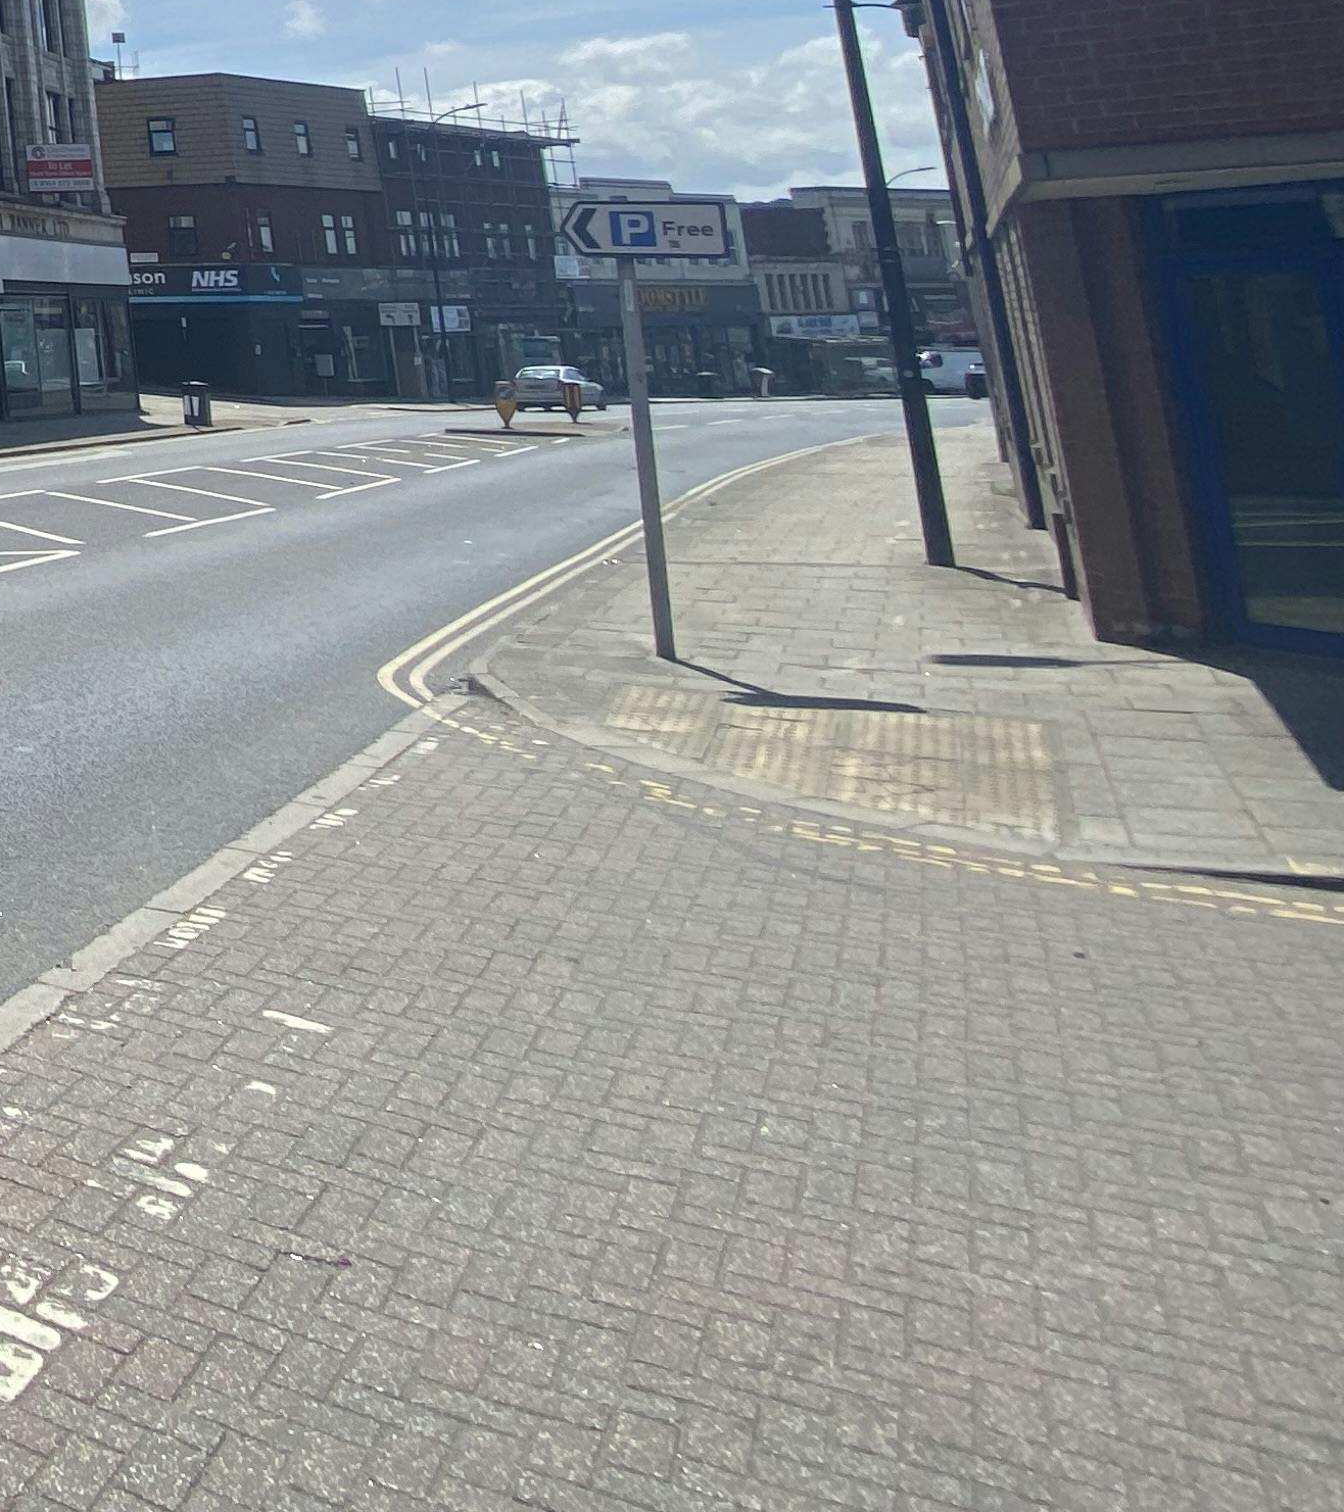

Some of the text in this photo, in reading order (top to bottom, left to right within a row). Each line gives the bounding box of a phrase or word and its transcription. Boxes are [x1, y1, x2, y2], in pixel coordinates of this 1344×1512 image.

[618, 212, 714, 245] P Free
[128, 272, 166, 285] son
[192, 270, 239, 288] NHS
[128, 287, 155, 296] LINIC
